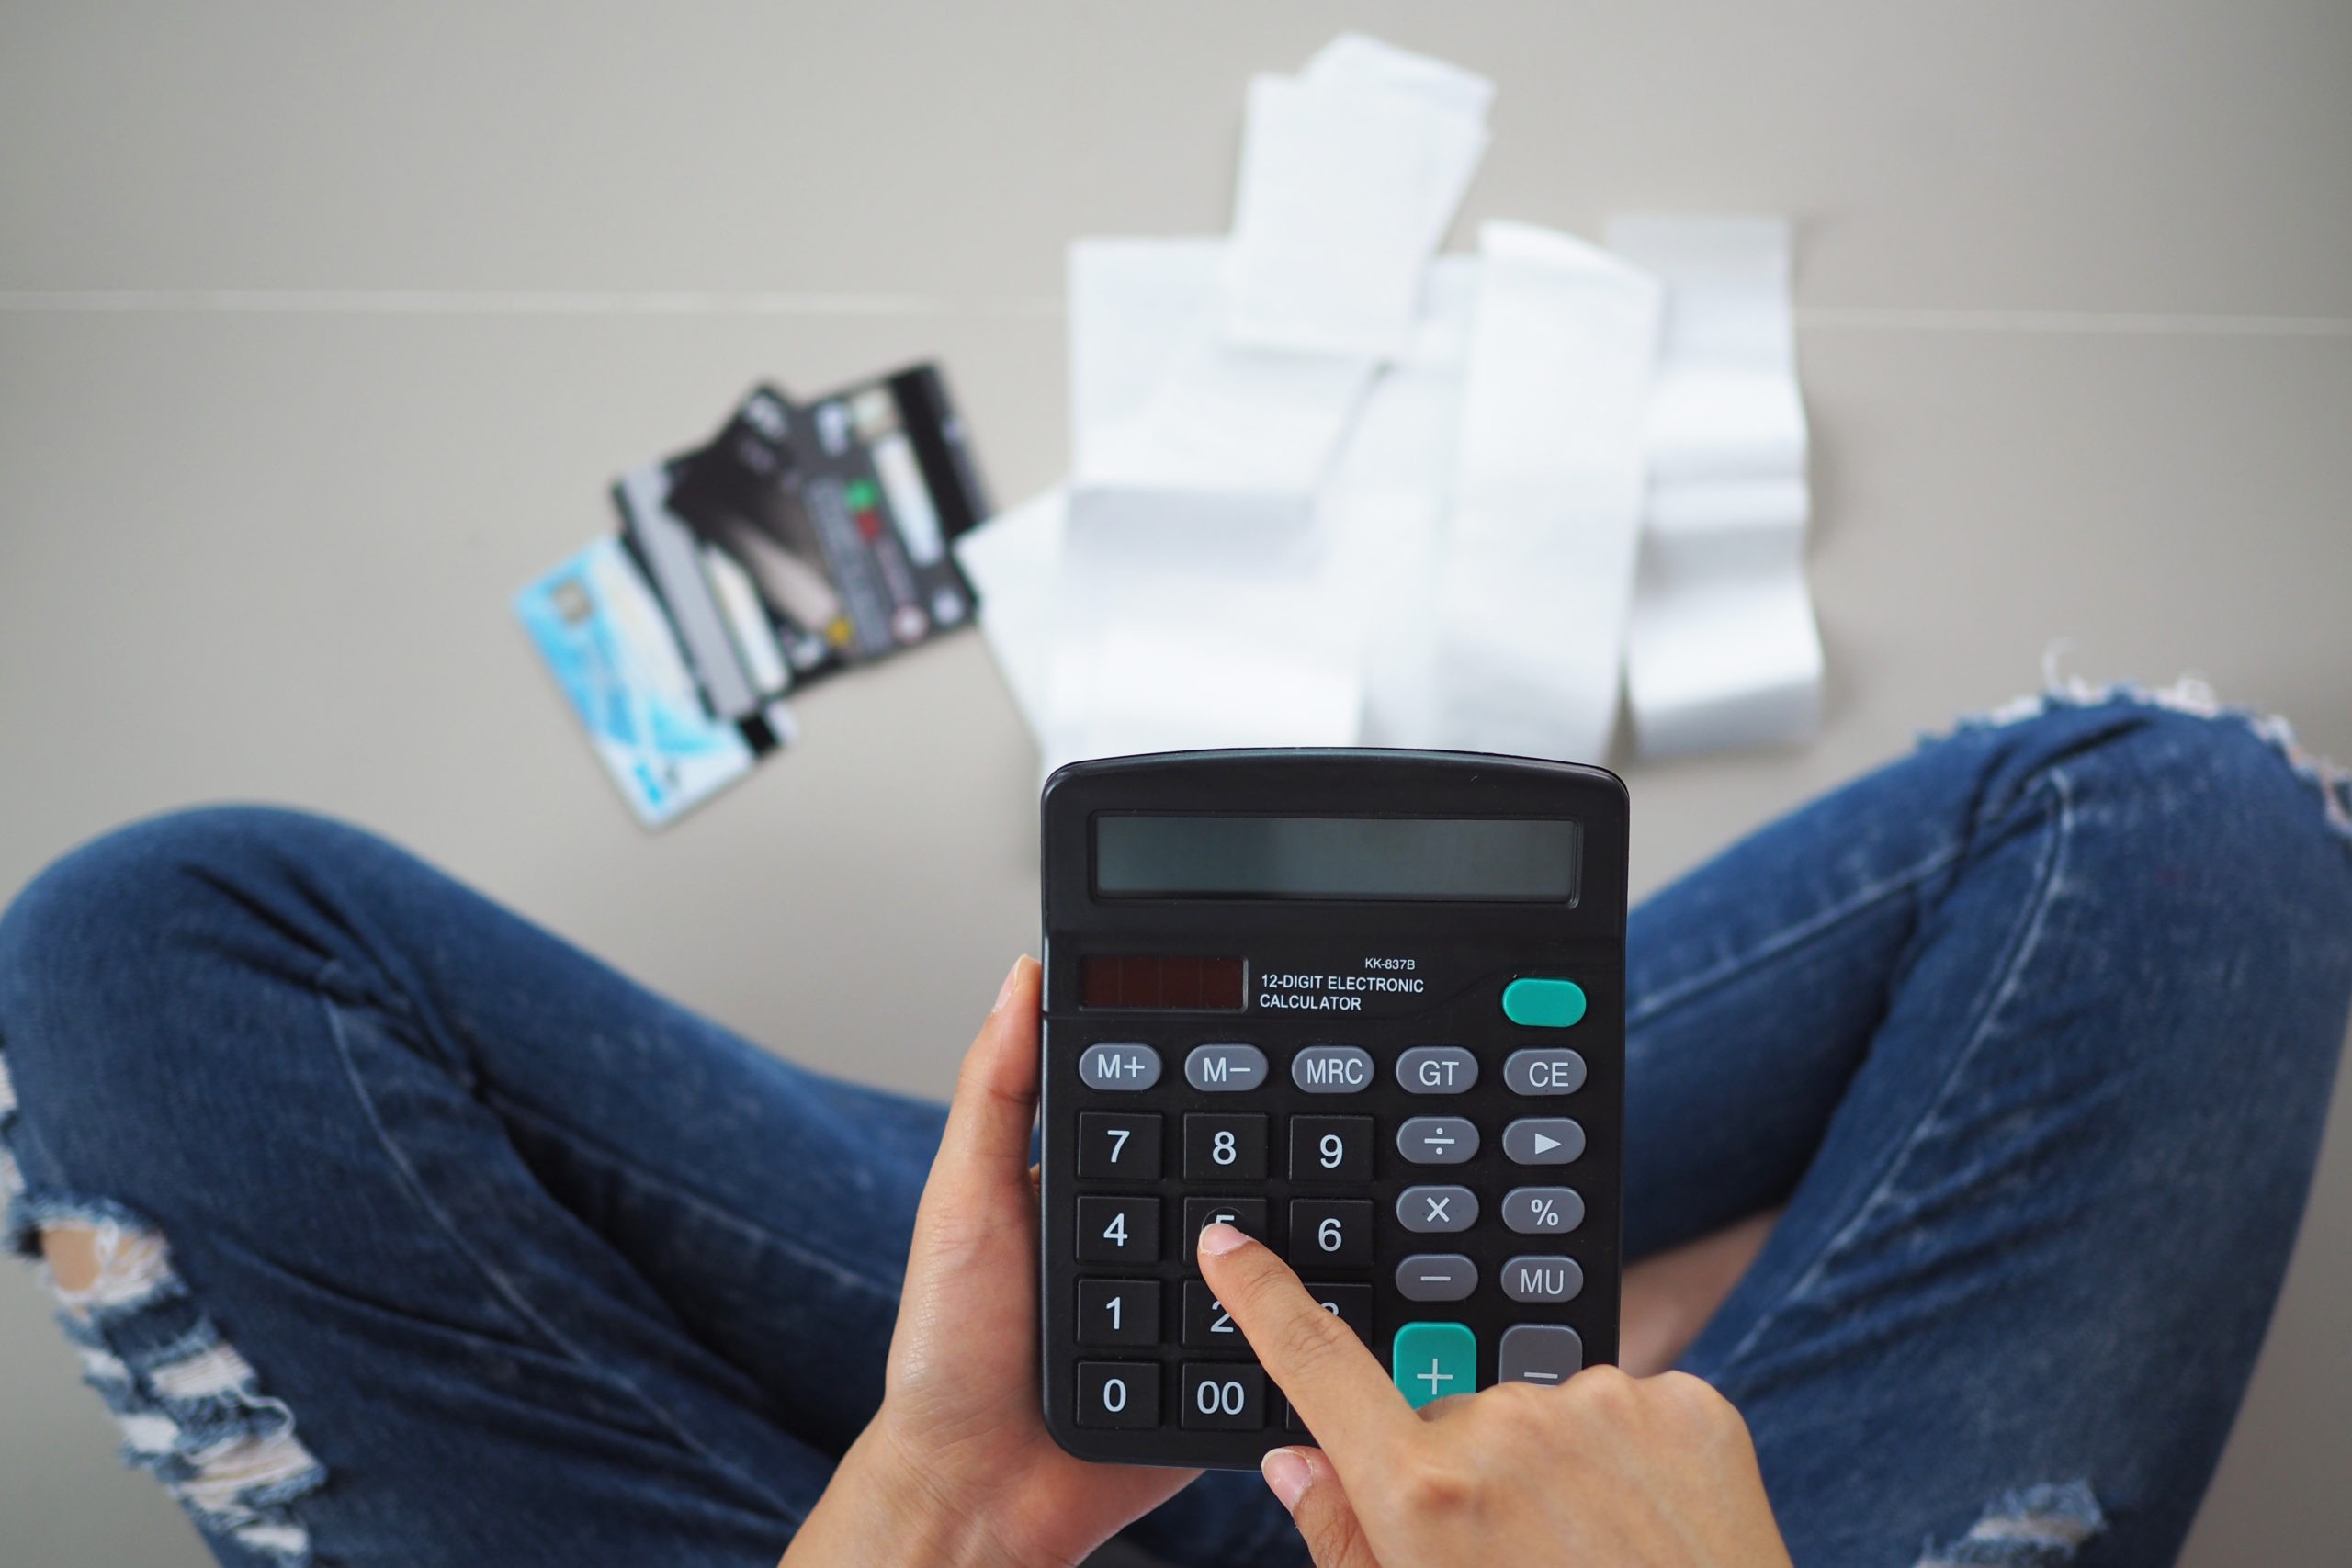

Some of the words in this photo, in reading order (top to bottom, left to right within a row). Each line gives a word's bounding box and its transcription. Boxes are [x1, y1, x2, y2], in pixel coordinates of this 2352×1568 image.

[1365, 957, 1416, 971] KK-837B
[1261, 974, 1324, 989] 12-DIGIT
[1328, 976, 1424, 993] ELECTRONIC
[1260, 994, 1362, 1011] CALCULATOR
[1098, 1053, 1146, 1079] M+
[1306, 1058, 1363, 1085] MRC
[1419, 1060, 1460, 1087] GT
[1529, 1061, 1569, 1088] CE
[1107, 1130, 1130, 1163] 7
[1212, 1131, 1237, 1165] 8
[1319, 1134, 1343, 1168] 9
[1103, 1213, 1128, 1247] 4
[1318, 1218, 1342, 1252] 6
[1521, 1269, 1564, 1295] MU
[1105, 1296, 1121, 1330] 1
[1210, 1300, 1234, 1333] 2
[1103, 1378, 1126, 1413] 0
[1196, 1380, 1245, 1416] 00
